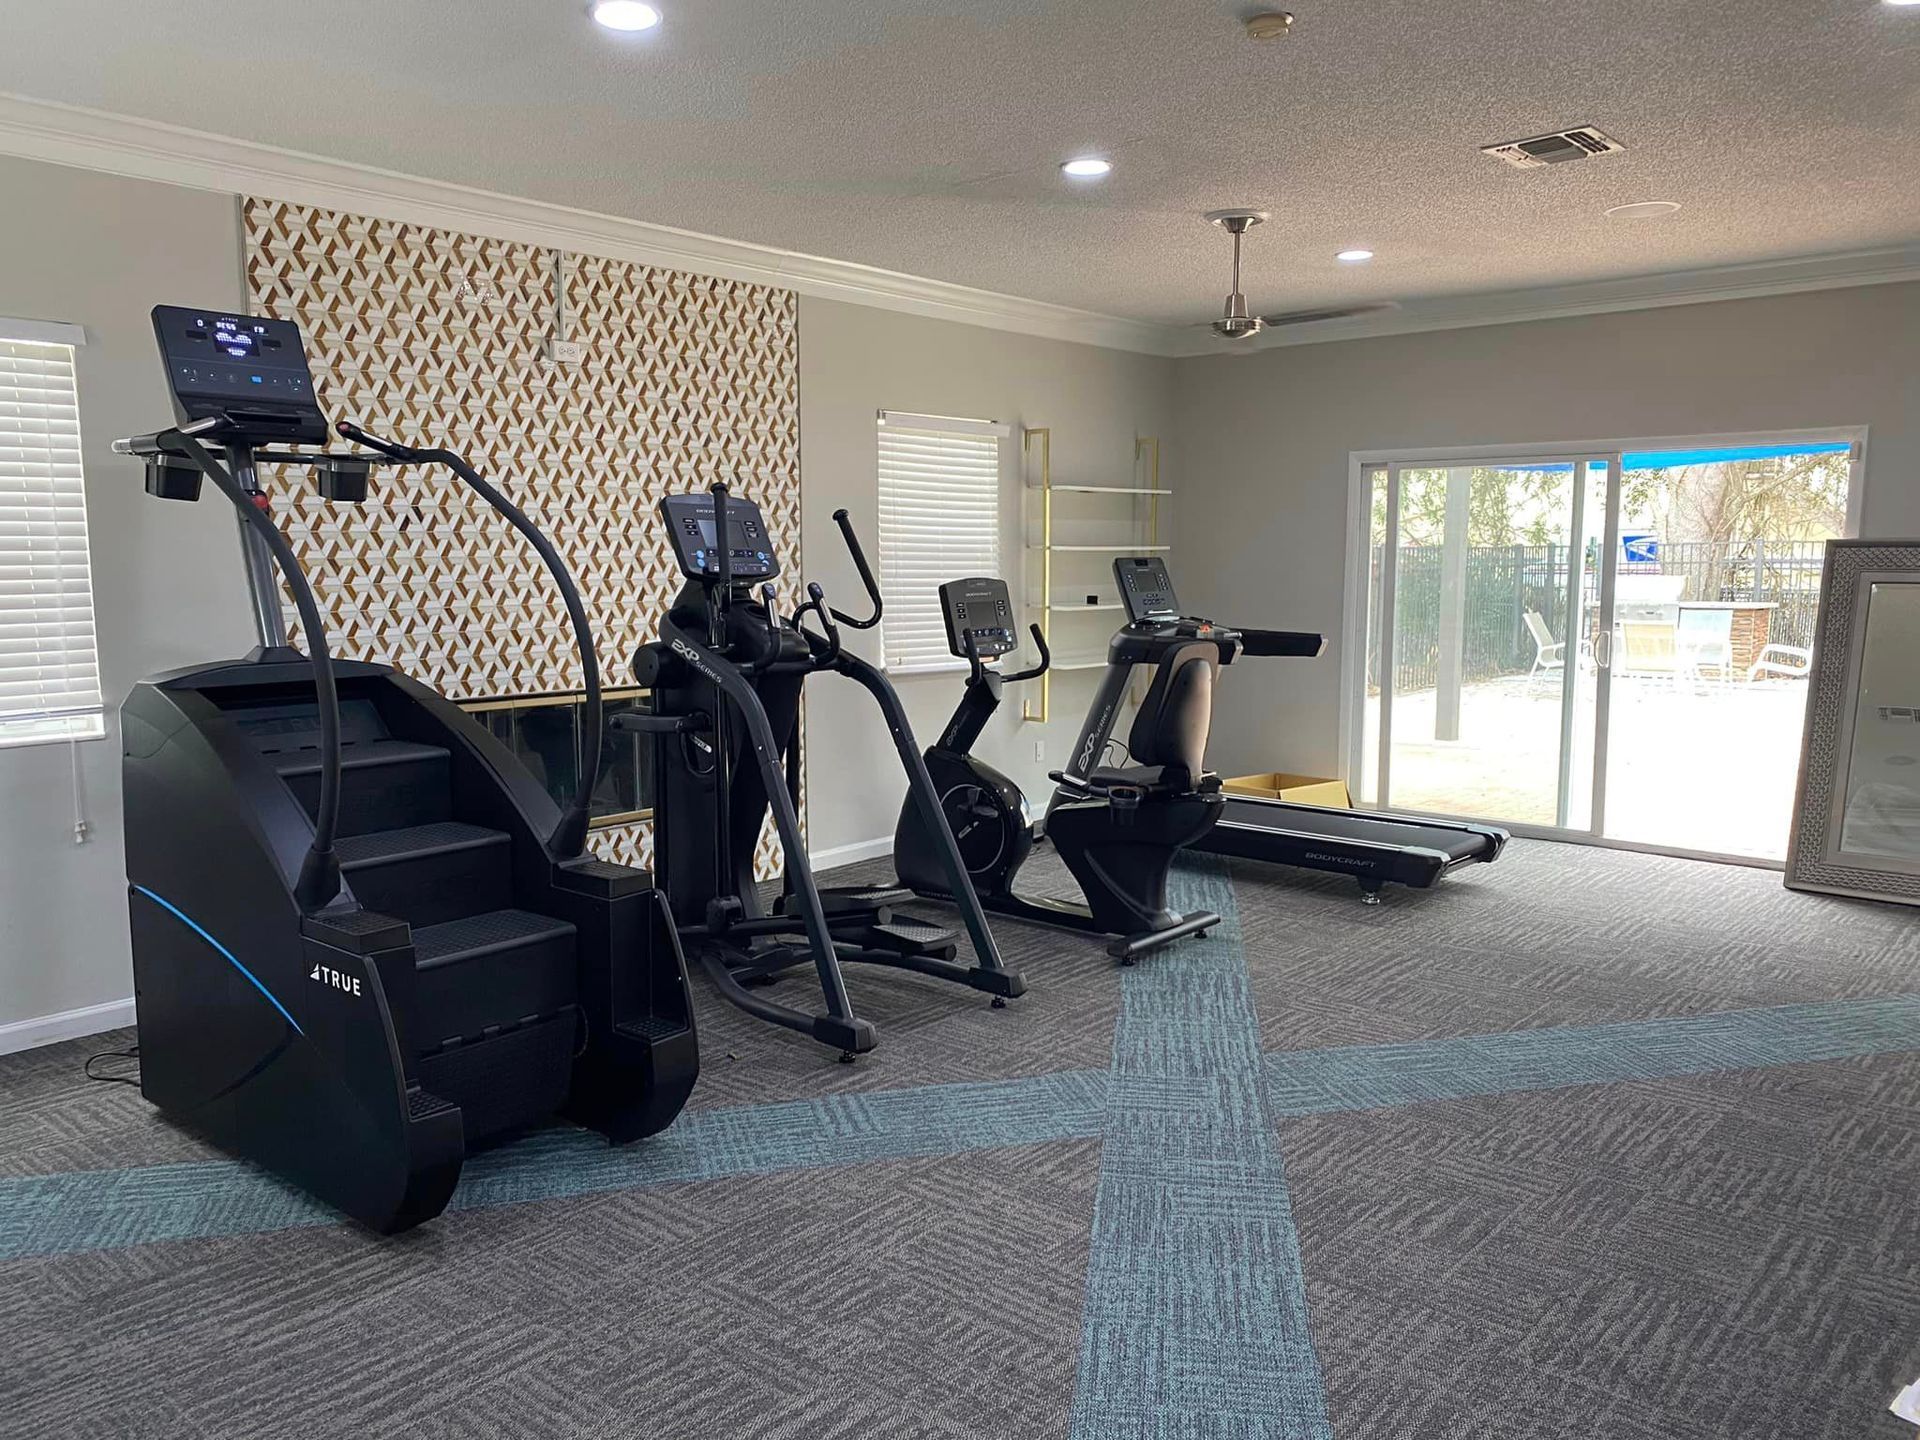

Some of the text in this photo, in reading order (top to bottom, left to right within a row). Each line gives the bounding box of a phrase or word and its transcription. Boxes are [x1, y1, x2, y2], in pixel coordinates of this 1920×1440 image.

[671, 638, 699, 661] EXP
[1078, 733, 1095, 773] EXP
[320, 965, 361, 996] TRUE
